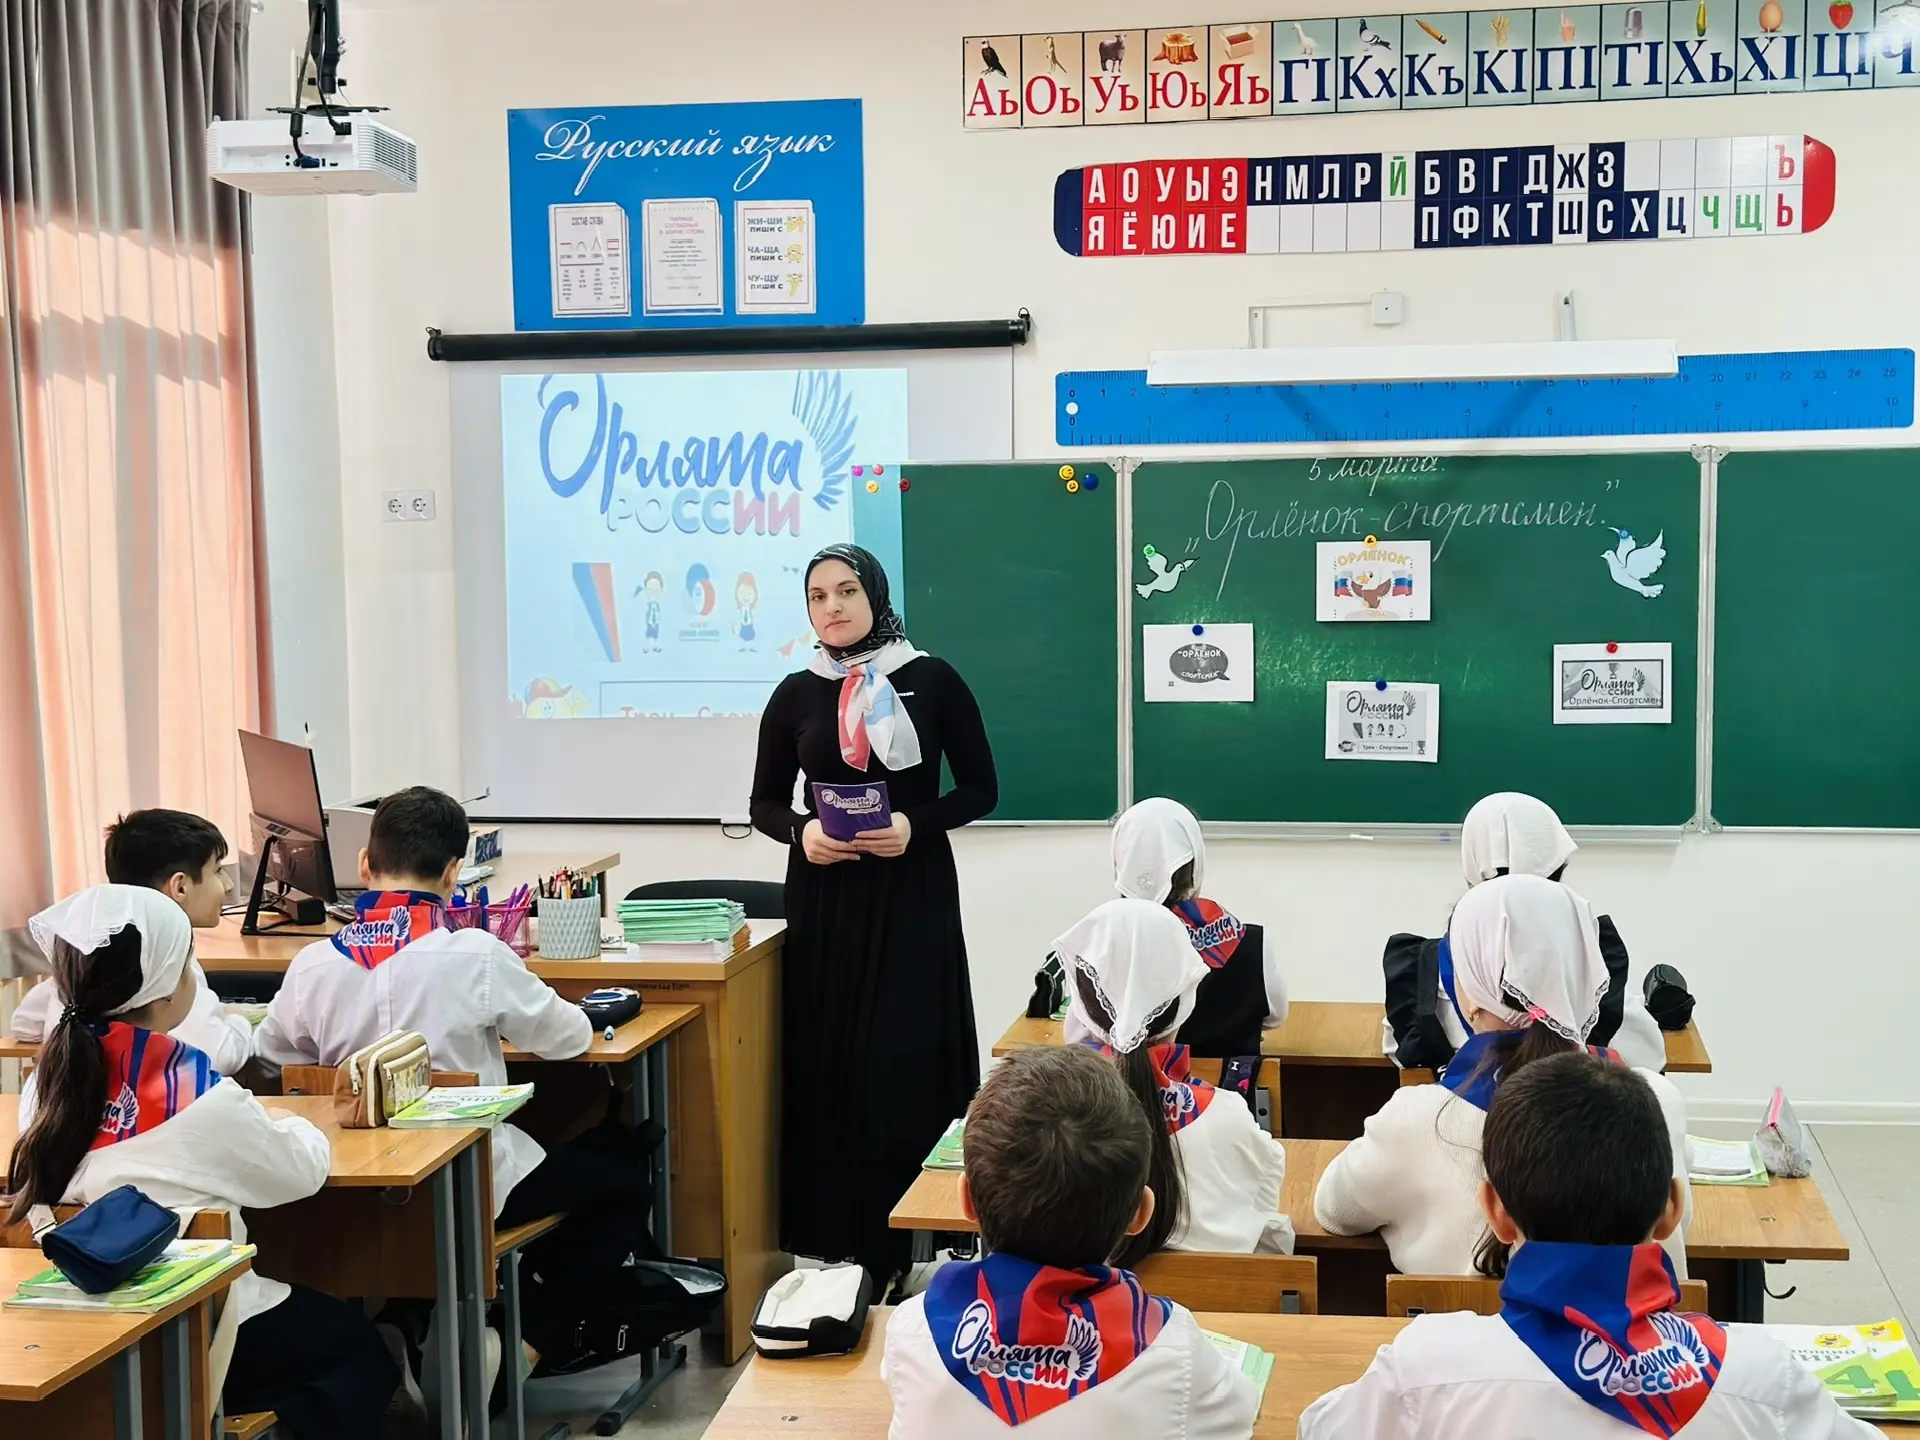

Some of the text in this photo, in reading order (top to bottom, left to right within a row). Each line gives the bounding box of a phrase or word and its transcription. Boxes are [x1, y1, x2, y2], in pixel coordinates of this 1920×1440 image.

[966, 77, 1018, 117] Аь
[1025, 75, 1081, 115] Оь
[1089, 75, 1139, 113] Уь
[1149, 71, 1207, 109] Юь
[1213, 63, 1270, 106] Яь
[1339, 54, 1398, 100] Кх
[1404, 52, 1465, 96] Къ
[1671, 39, 1734, 85] Хь
[535, 115, 836, 197] Русский язык
[1088, 144, 1795, 203] А О У Ы Э Н М Л Р Й Б В Г Д Ж З Ъ
[1088, 193, 1793, 250] Я Ё Ю И Е П Ф К Т Ш С Х Ц Ч Щ Ь
[537, 372, 804, 514] Орлята
[1581, 669, 1635, 692] Орлята
[1346, 690, 1405, 716] Орлята
[340, 922, 394, 941] рлята
[1186, 917, 1233, 940] рлята
[1192, 928, 1236, 949] ОССИИ
[956, 1303, 1070, 1366] Орлята
[972, 1360, 1068, 1386] РОССИИ
[1579, 1331, 1688, 1387] Орлята
[1606, 1362, 1699, 1393] РОССИИ
